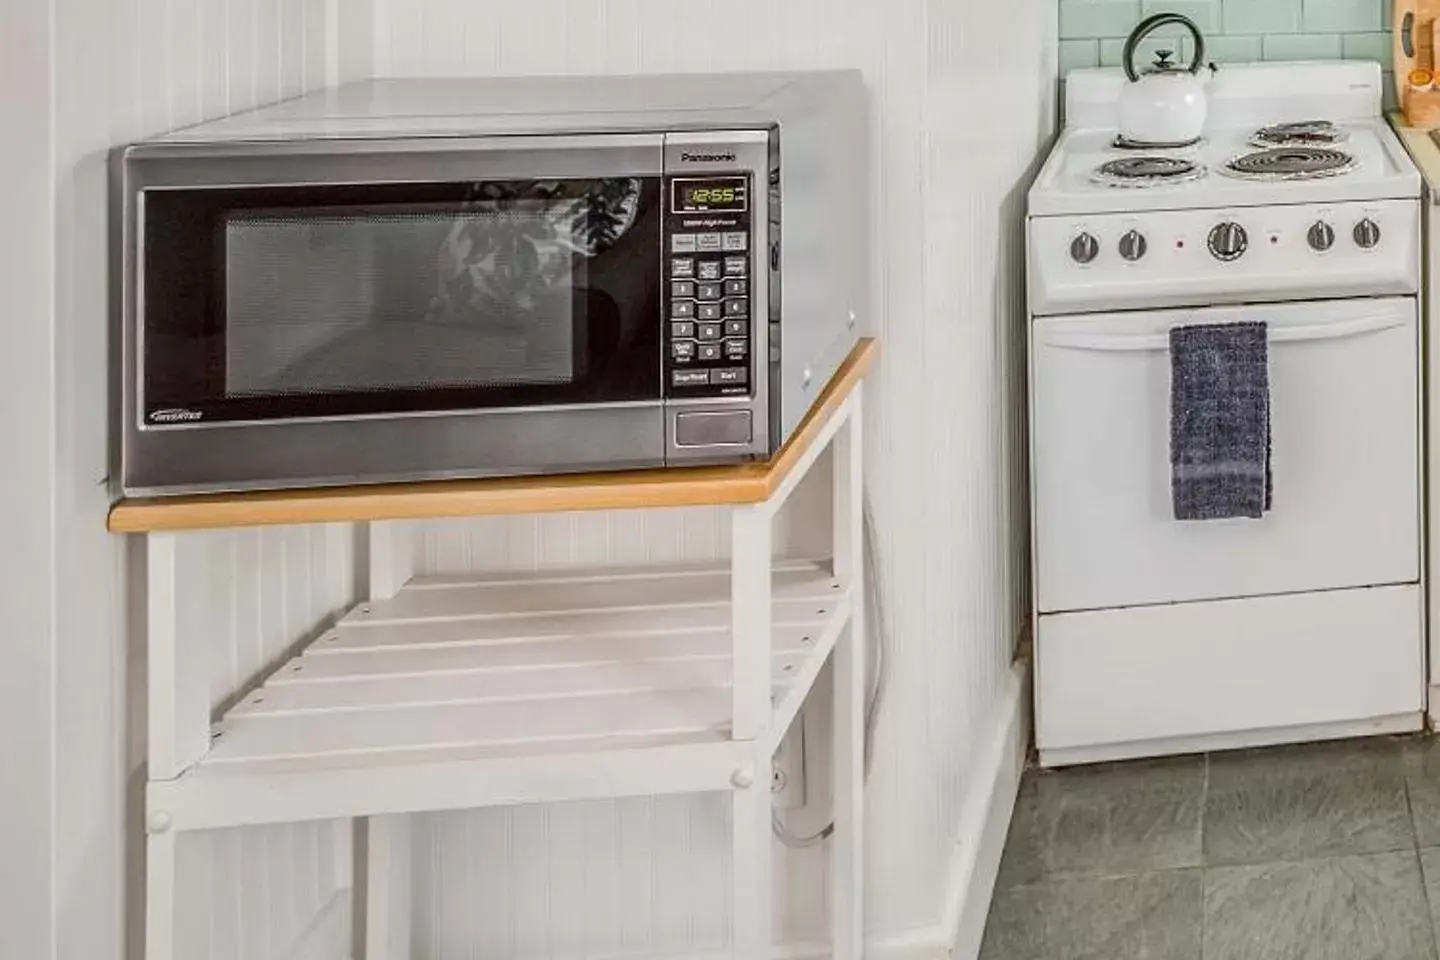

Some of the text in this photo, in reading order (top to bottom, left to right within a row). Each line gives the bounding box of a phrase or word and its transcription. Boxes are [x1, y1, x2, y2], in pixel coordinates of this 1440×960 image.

[681, 152, 736, 162] Panasonic
[692, 188, 735, 203] 12:55
[681, 284, 686, 293] 1
[706, 287, 713, 297] 2
[680, 305, 687, 313] 4
[681, 325, 687, 334] 7
[706, 348, 714, 357] 0
